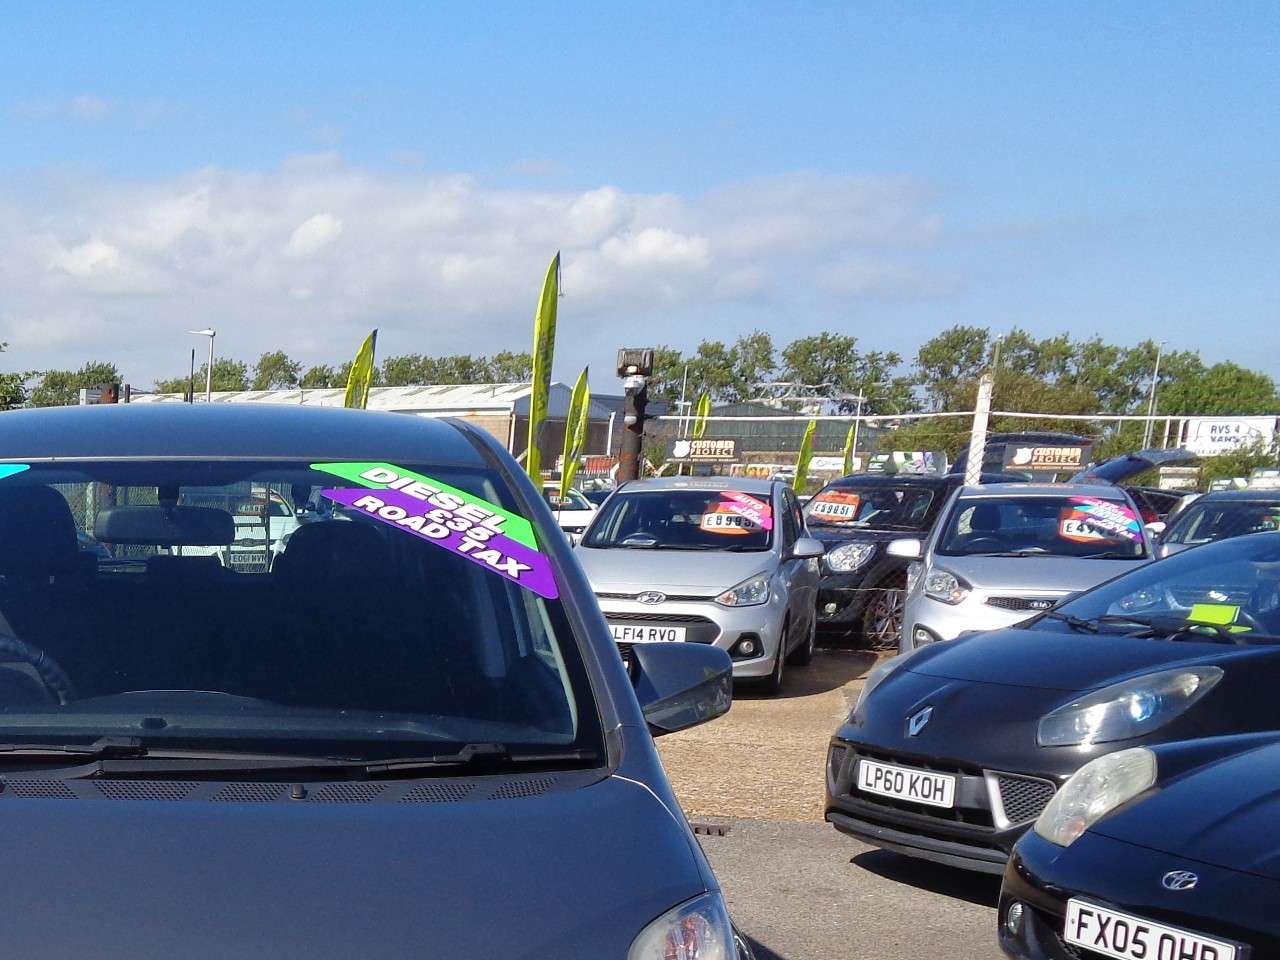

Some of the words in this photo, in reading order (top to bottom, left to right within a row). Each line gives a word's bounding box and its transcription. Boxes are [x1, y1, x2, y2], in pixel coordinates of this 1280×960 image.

[690, 448, 734, 456] PROTECT
[691, 440, 735, 449] CUSTOMER
[1033, 448, 1081, 456] CUSTOMER
[1032, 455, 1080, 463] PROTECT
[360, 467, 507, 535] DIESEL
[352, 495, 451, 540] ROAD
[456, 537, 533, 579] TAX
[424, 508, 497, 542] £35
[614, 627, 644, 641] LF14
[648, 628, 677, 642] RVO
[865, 765, 905, 794] LP60
[908, 774, 946, 801] KOH
[1076, 908, 1150, 960] FX05
